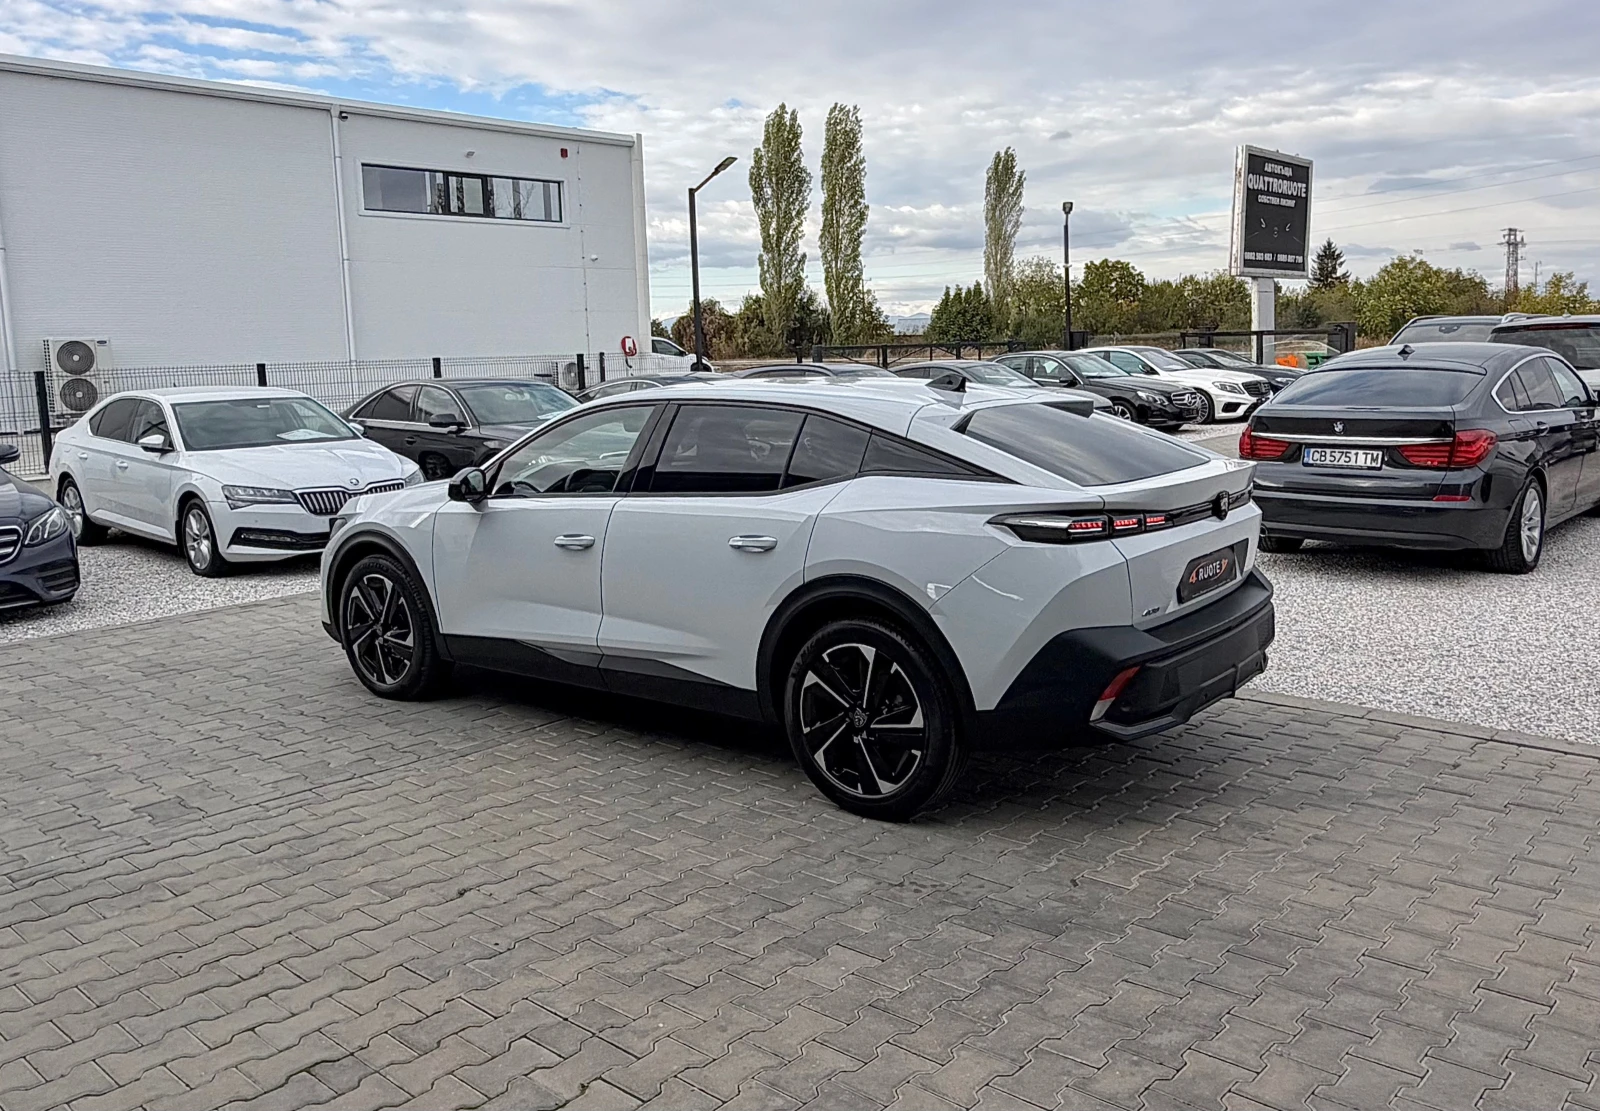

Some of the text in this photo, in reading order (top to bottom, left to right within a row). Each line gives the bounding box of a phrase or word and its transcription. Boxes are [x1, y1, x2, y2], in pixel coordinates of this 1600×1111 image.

[1247, 173, 1306, 197] QUATTRORUOTE
[1311, 450, 1379, 465] CB 5751 TM
[1198, 560, 1220, 581] RUOTE
